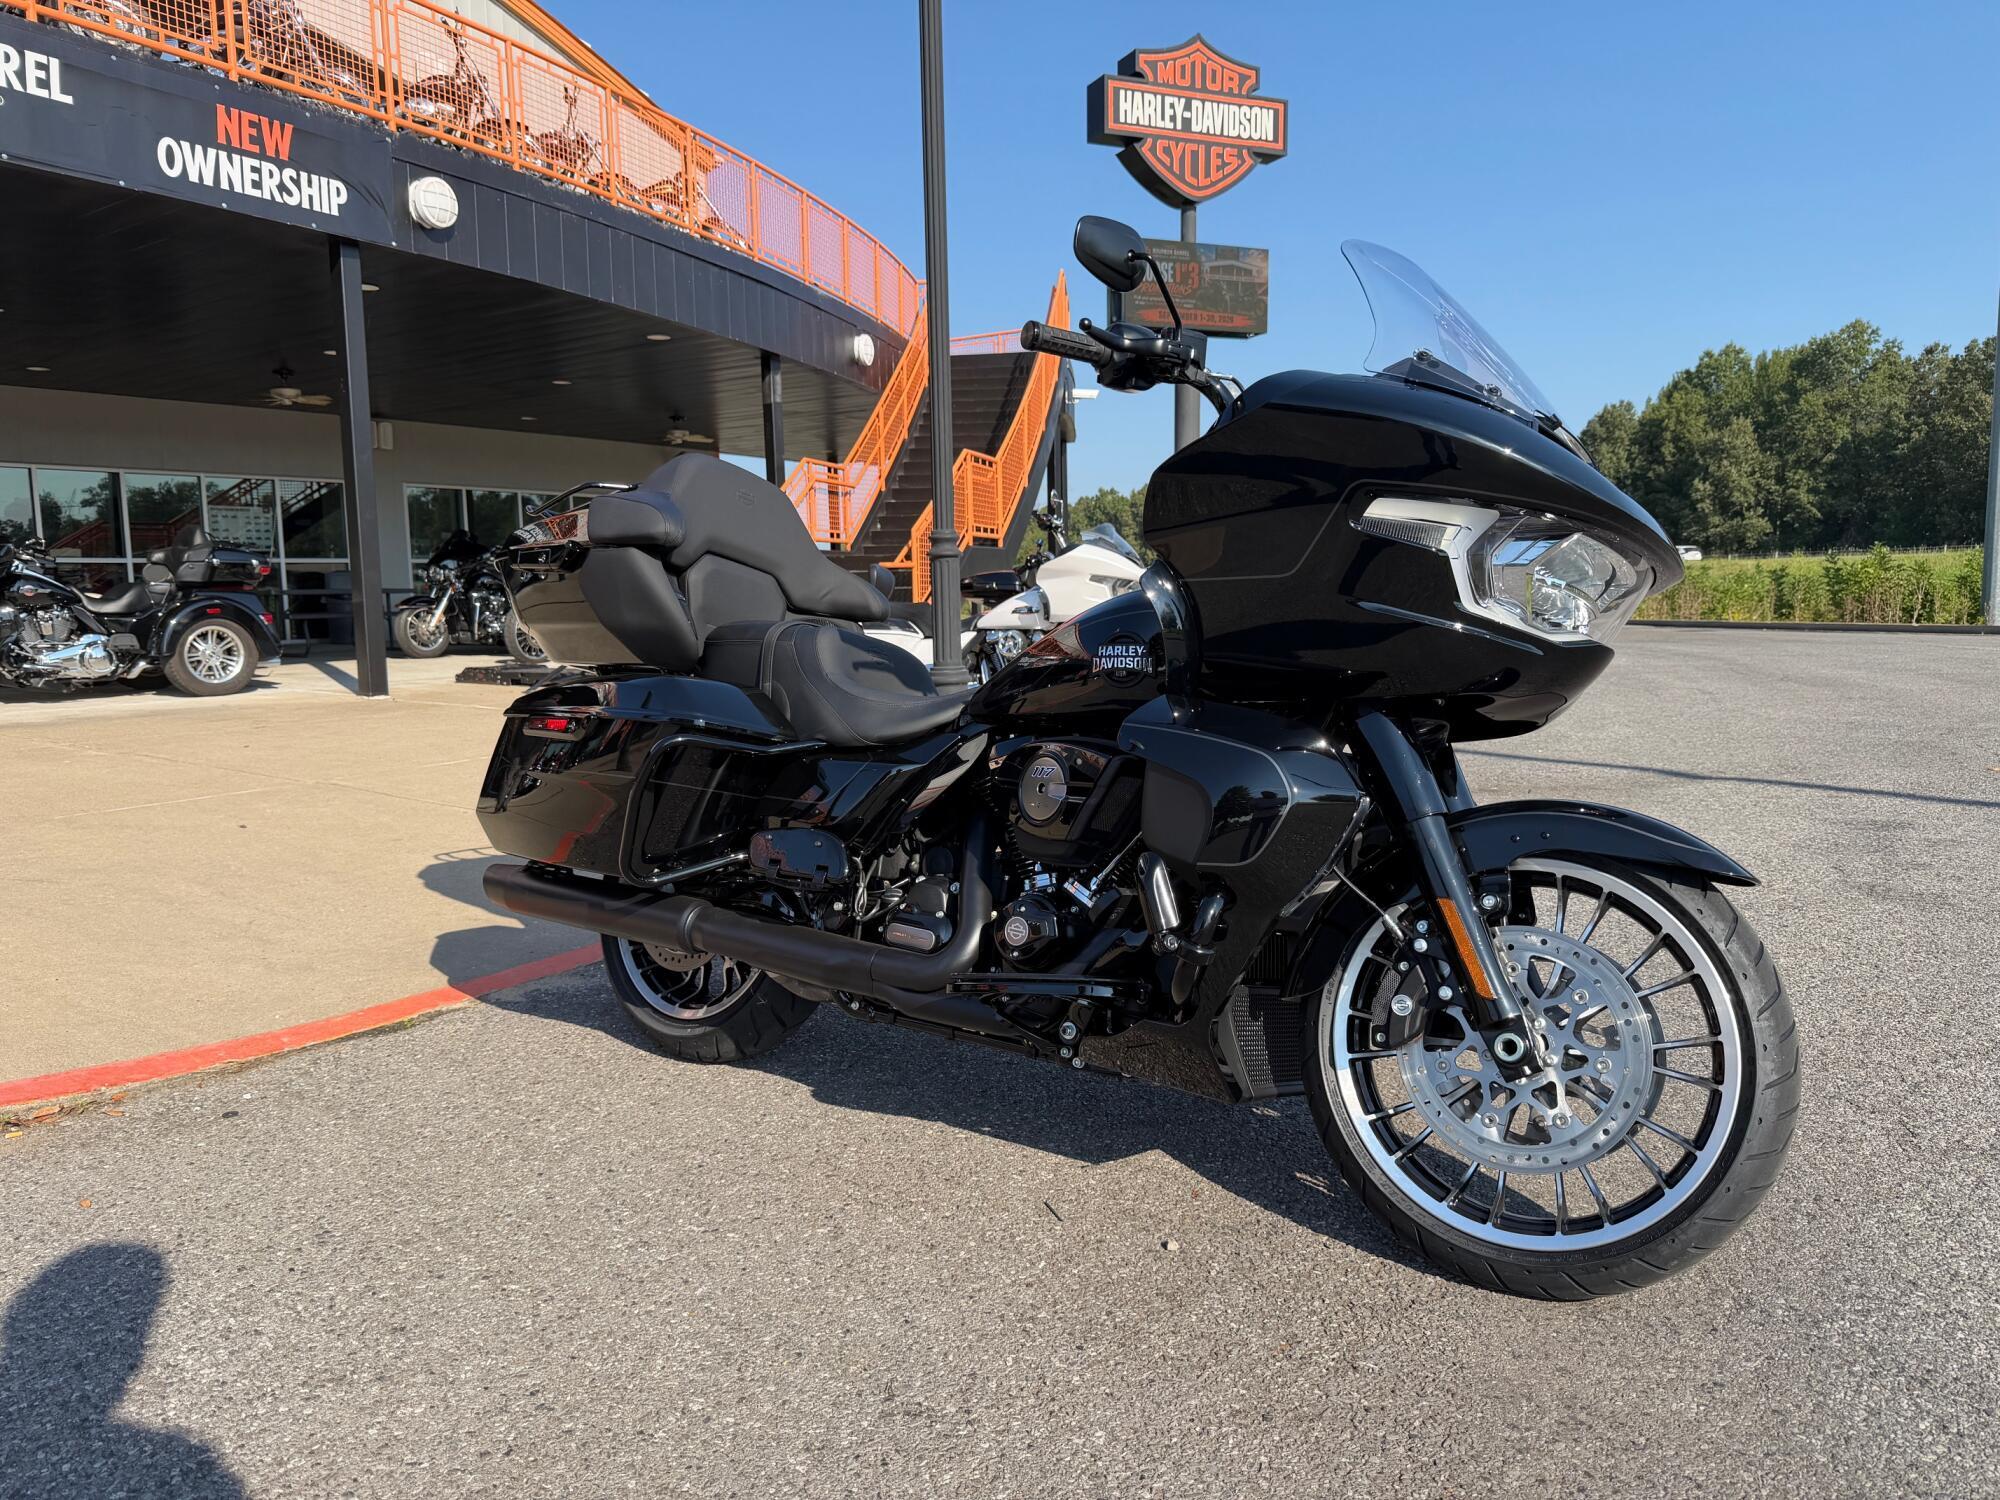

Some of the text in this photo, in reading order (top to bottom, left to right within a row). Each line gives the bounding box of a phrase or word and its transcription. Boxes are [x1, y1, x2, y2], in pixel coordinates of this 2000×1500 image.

[1157, 51, 1240, 94] MOTOR
[216, 103, 294, 161] NEW
[1119, 89, 1274, 142] HARLEY-DAVIDSON
[157, 136, 348, 217] OWNERSHIP
[1156, 139, 1240, 187] CYCLES
[1092, 657, 1153, 674] DAVIDSON
[1098, 645, 1147, 656] HARLEY-
[1031, 765, 1057, 778] 117
